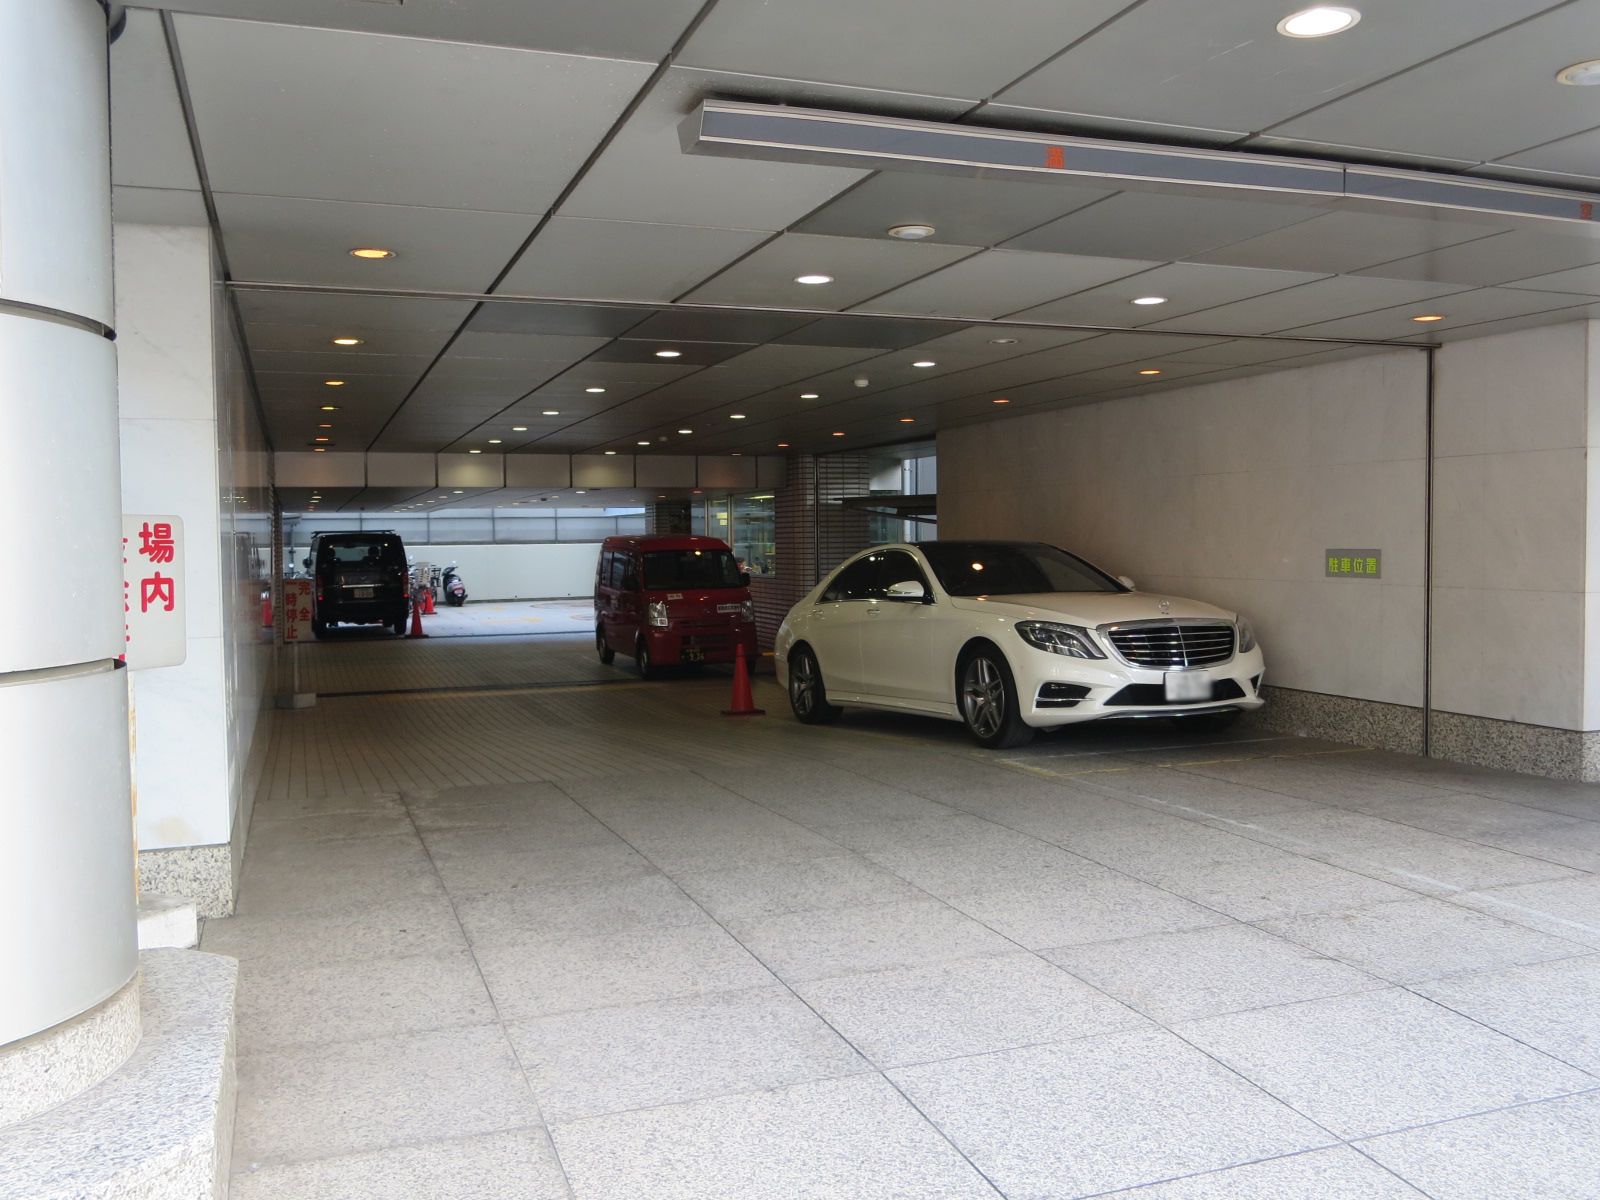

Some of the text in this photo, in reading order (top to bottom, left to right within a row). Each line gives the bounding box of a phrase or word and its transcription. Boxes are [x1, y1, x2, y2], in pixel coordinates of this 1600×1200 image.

[138, 522, 175, 613] 場内
[1328, 557, 1377, 574] 駐車位置
